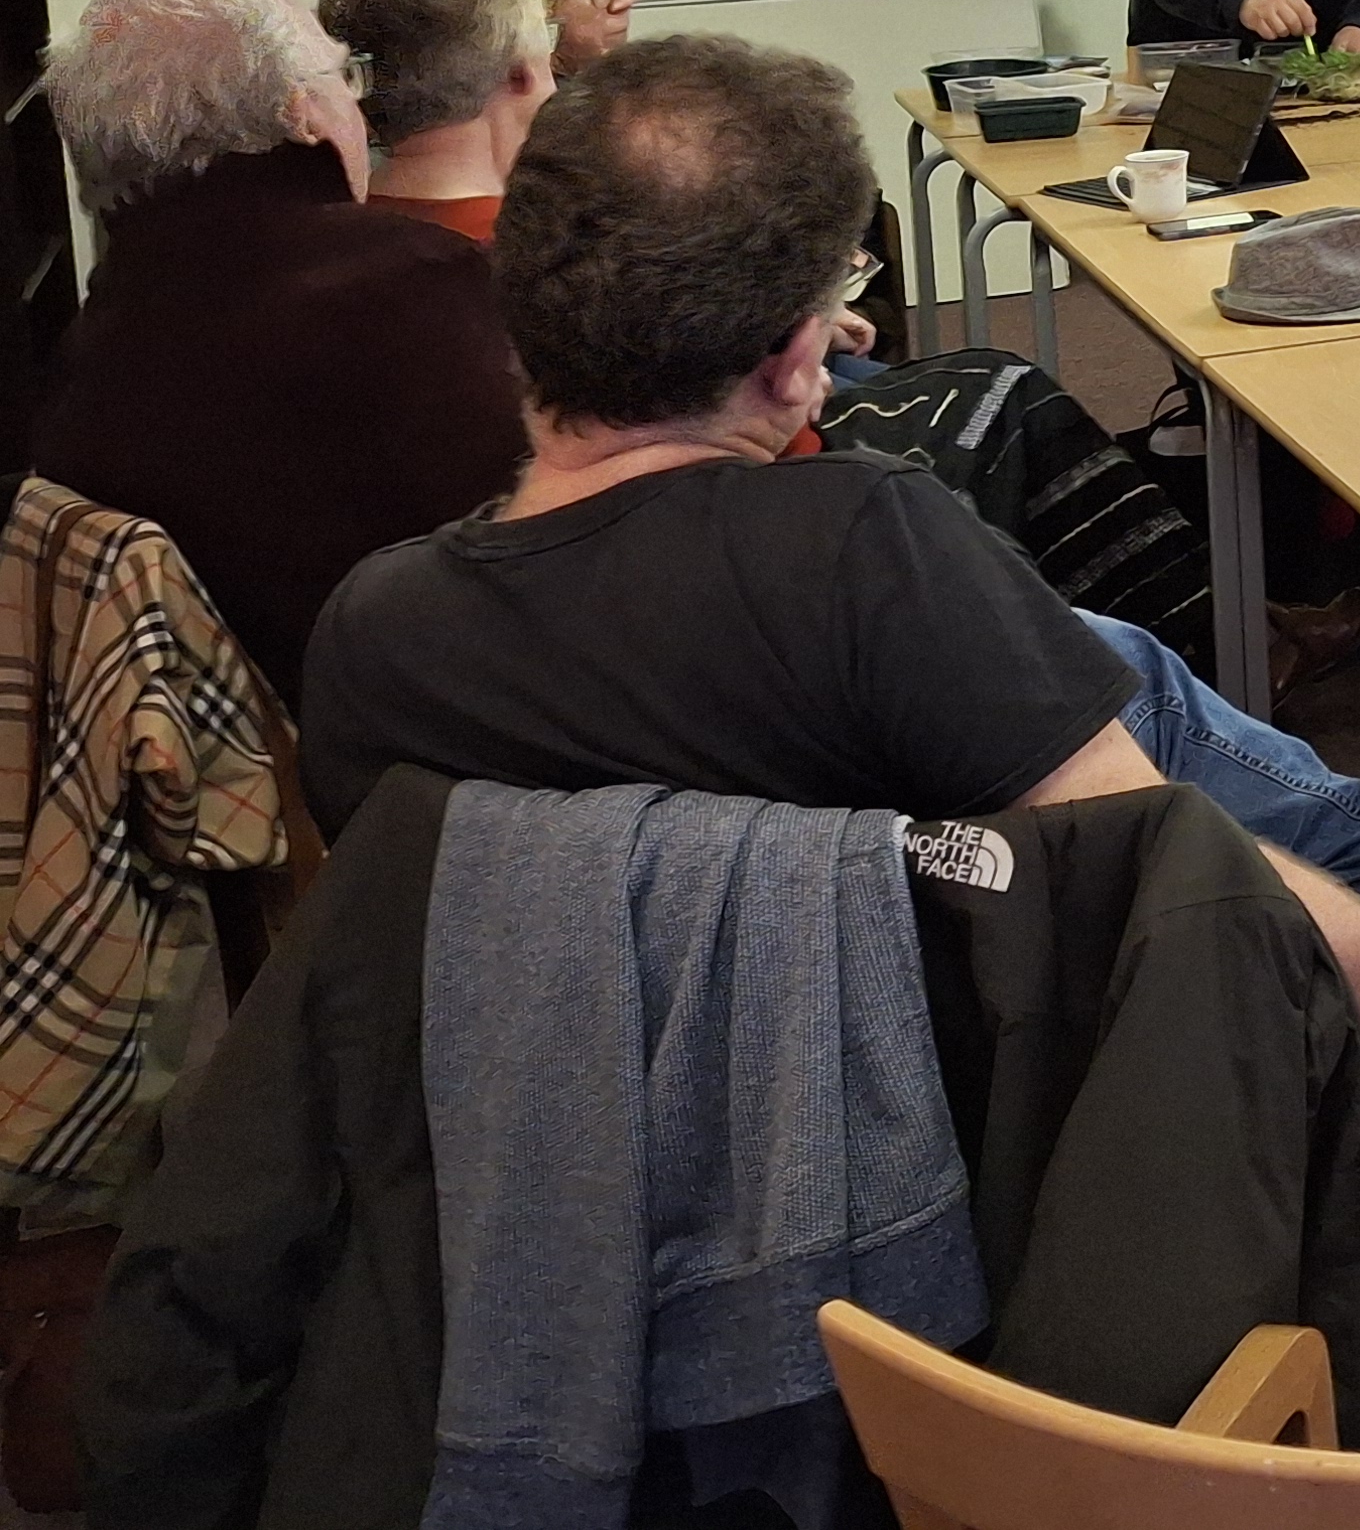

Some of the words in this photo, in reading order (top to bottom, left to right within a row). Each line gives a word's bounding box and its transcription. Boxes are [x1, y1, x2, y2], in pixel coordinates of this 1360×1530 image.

[941, 820, 984, 846] THE
[904, 832, 978, 865] NORTH
[916, 855, 972, 883] FACE
